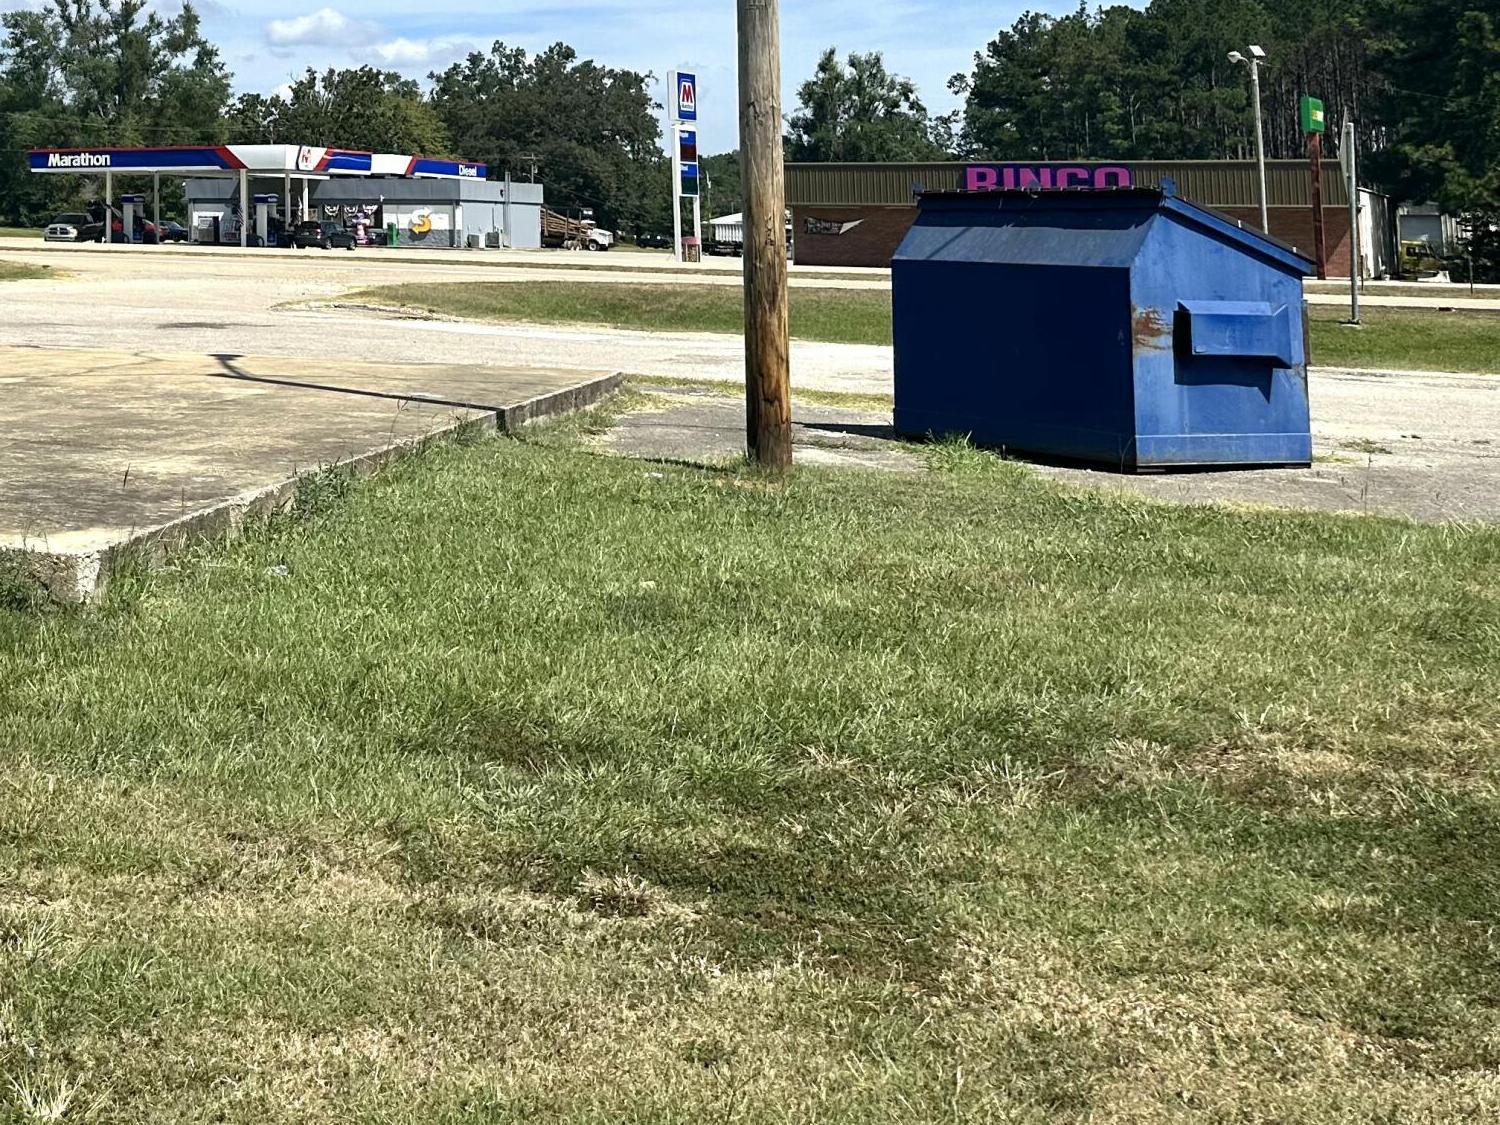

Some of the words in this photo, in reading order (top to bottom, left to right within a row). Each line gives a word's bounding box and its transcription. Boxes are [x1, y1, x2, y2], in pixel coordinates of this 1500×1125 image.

[682, 84, 694, 104] M
[47, 152, 111, 167] Marathon
[458, 164, 477, 177] Diesel
